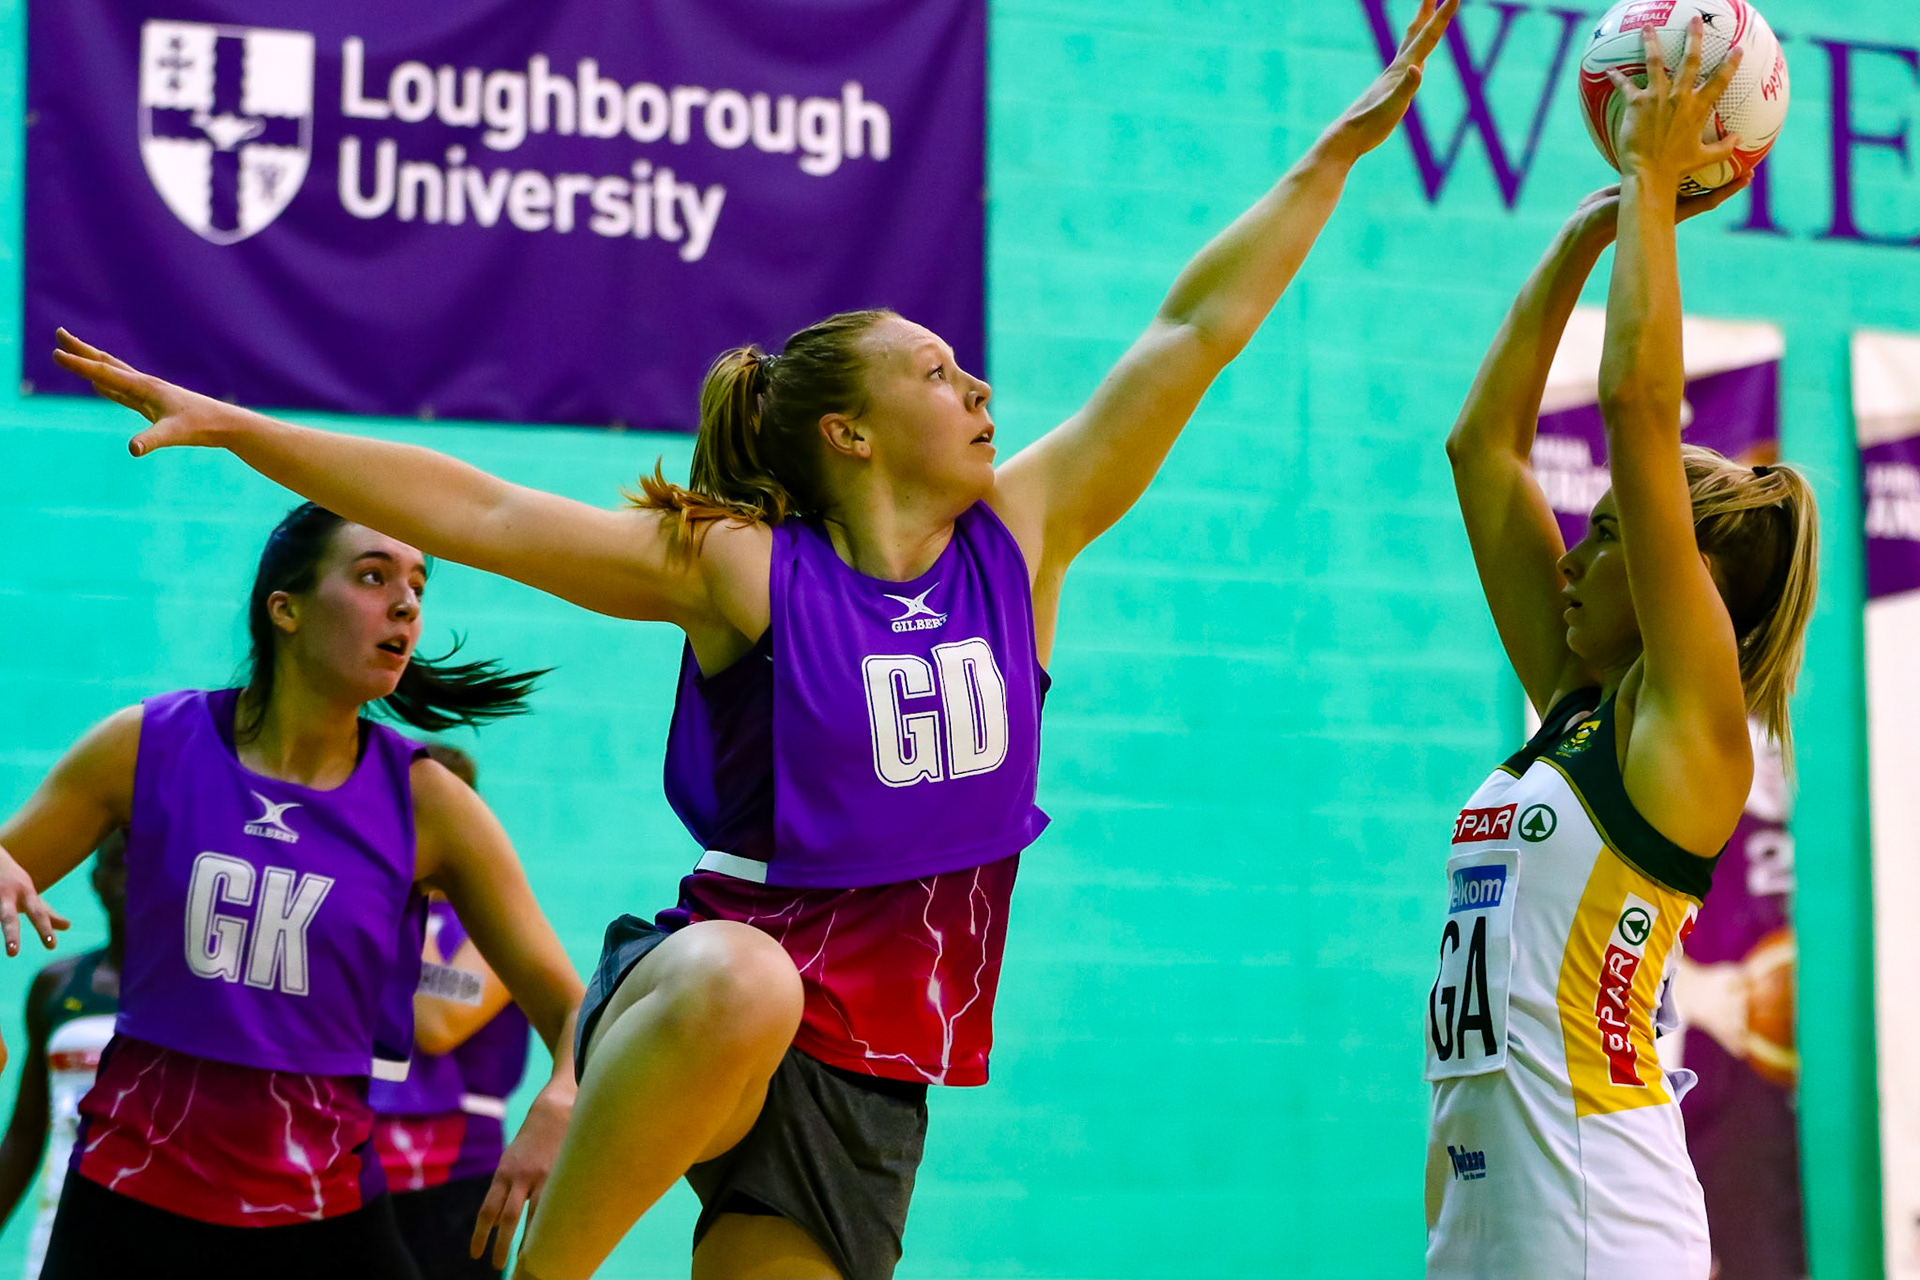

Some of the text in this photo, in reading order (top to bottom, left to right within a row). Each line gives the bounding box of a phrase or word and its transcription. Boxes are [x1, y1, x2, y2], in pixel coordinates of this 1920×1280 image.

[1622, 12, 1668, 25] NETBALL
[342, 37, 891, 177] Loughborough
[339, 137, 726, 262] University
[891, 614, 948, 633] GILBERT
[861, 636, 1009, 788] GD
[243, 824, 299, 844] GILBERT
[1451, 873, 1502, 908] elkom
[185, 851, 335, 996] GK
[1429, 915, 1498, 1062] GA
[1600, 952, 1634, 1053] SPAR
